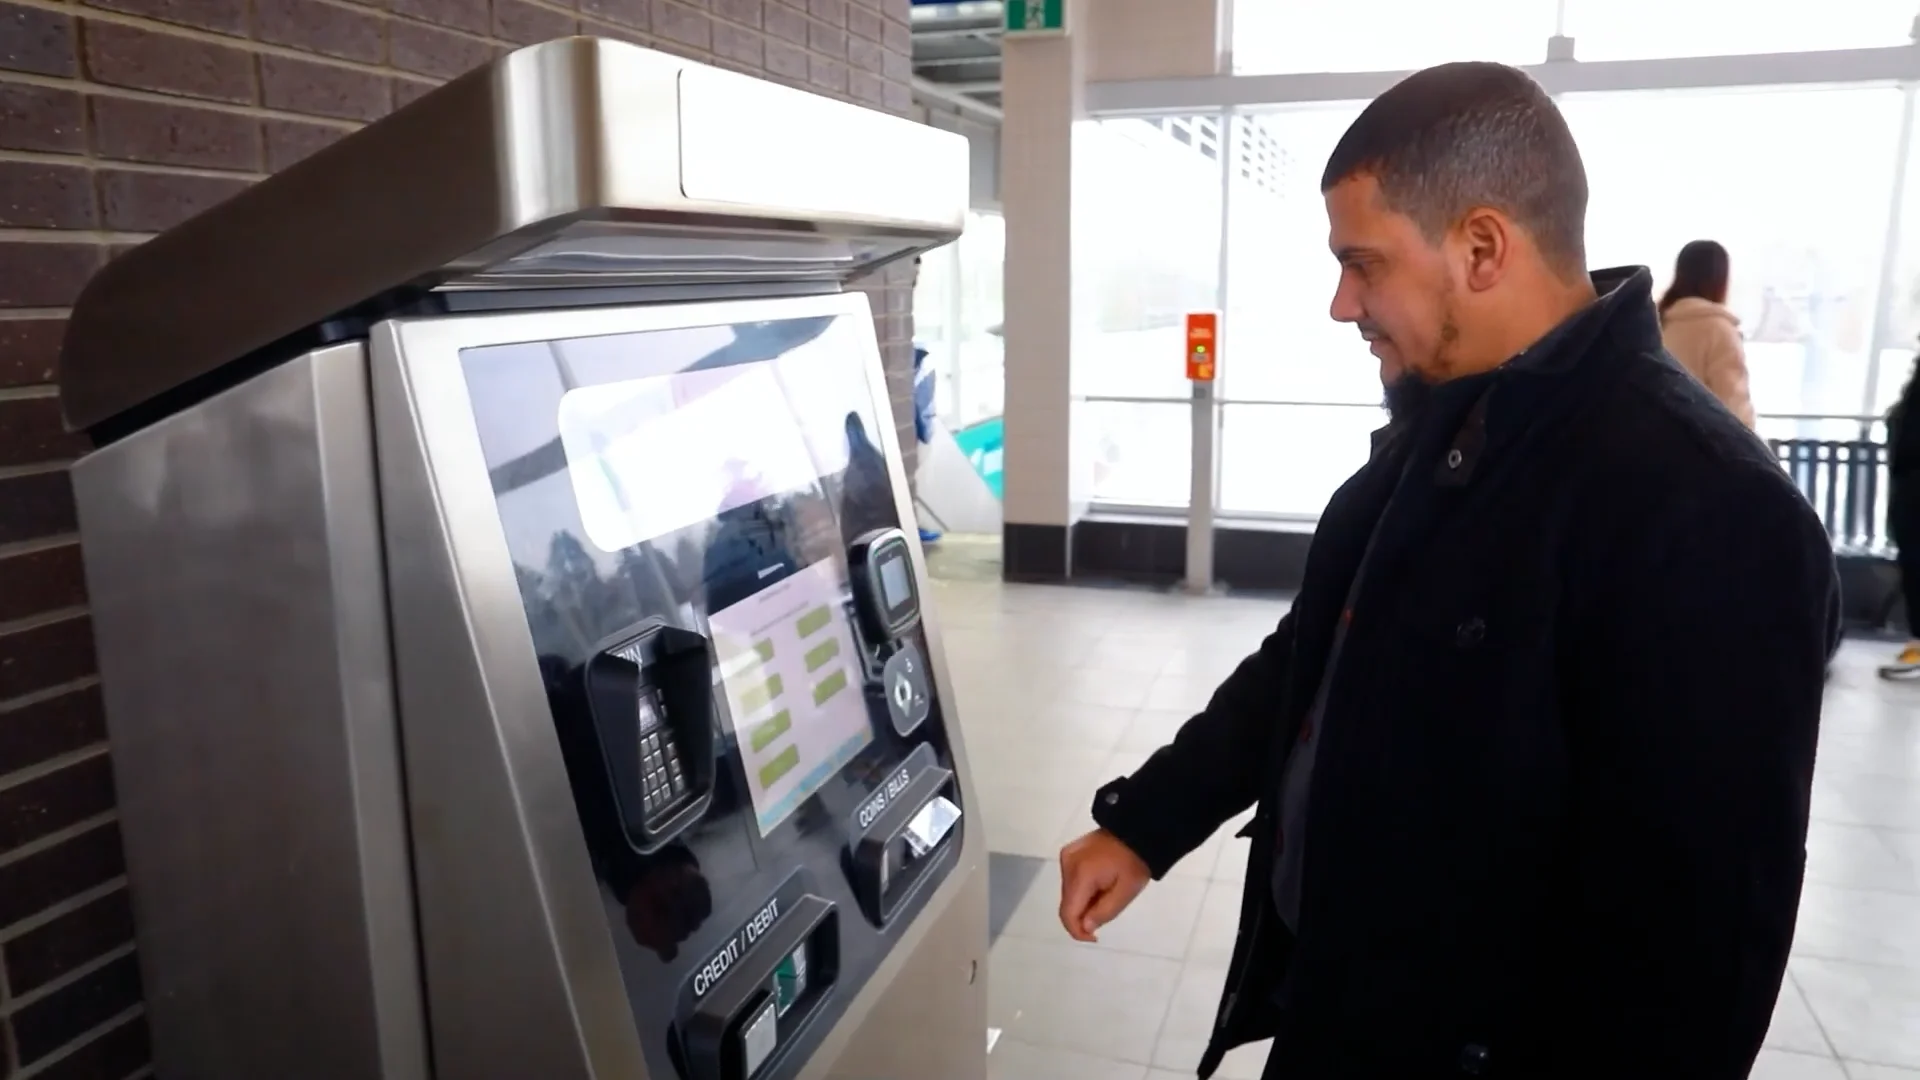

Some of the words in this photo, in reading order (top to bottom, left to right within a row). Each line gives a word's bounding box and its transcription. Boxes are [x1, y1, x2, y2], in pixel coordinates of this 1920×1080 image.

[859, 792, 885, 828] COINS
[887, 768, 910, 799] BILLS
[694, 938, 738, 996] CREDIT
[746, 897, 778, 943] DEBIT
